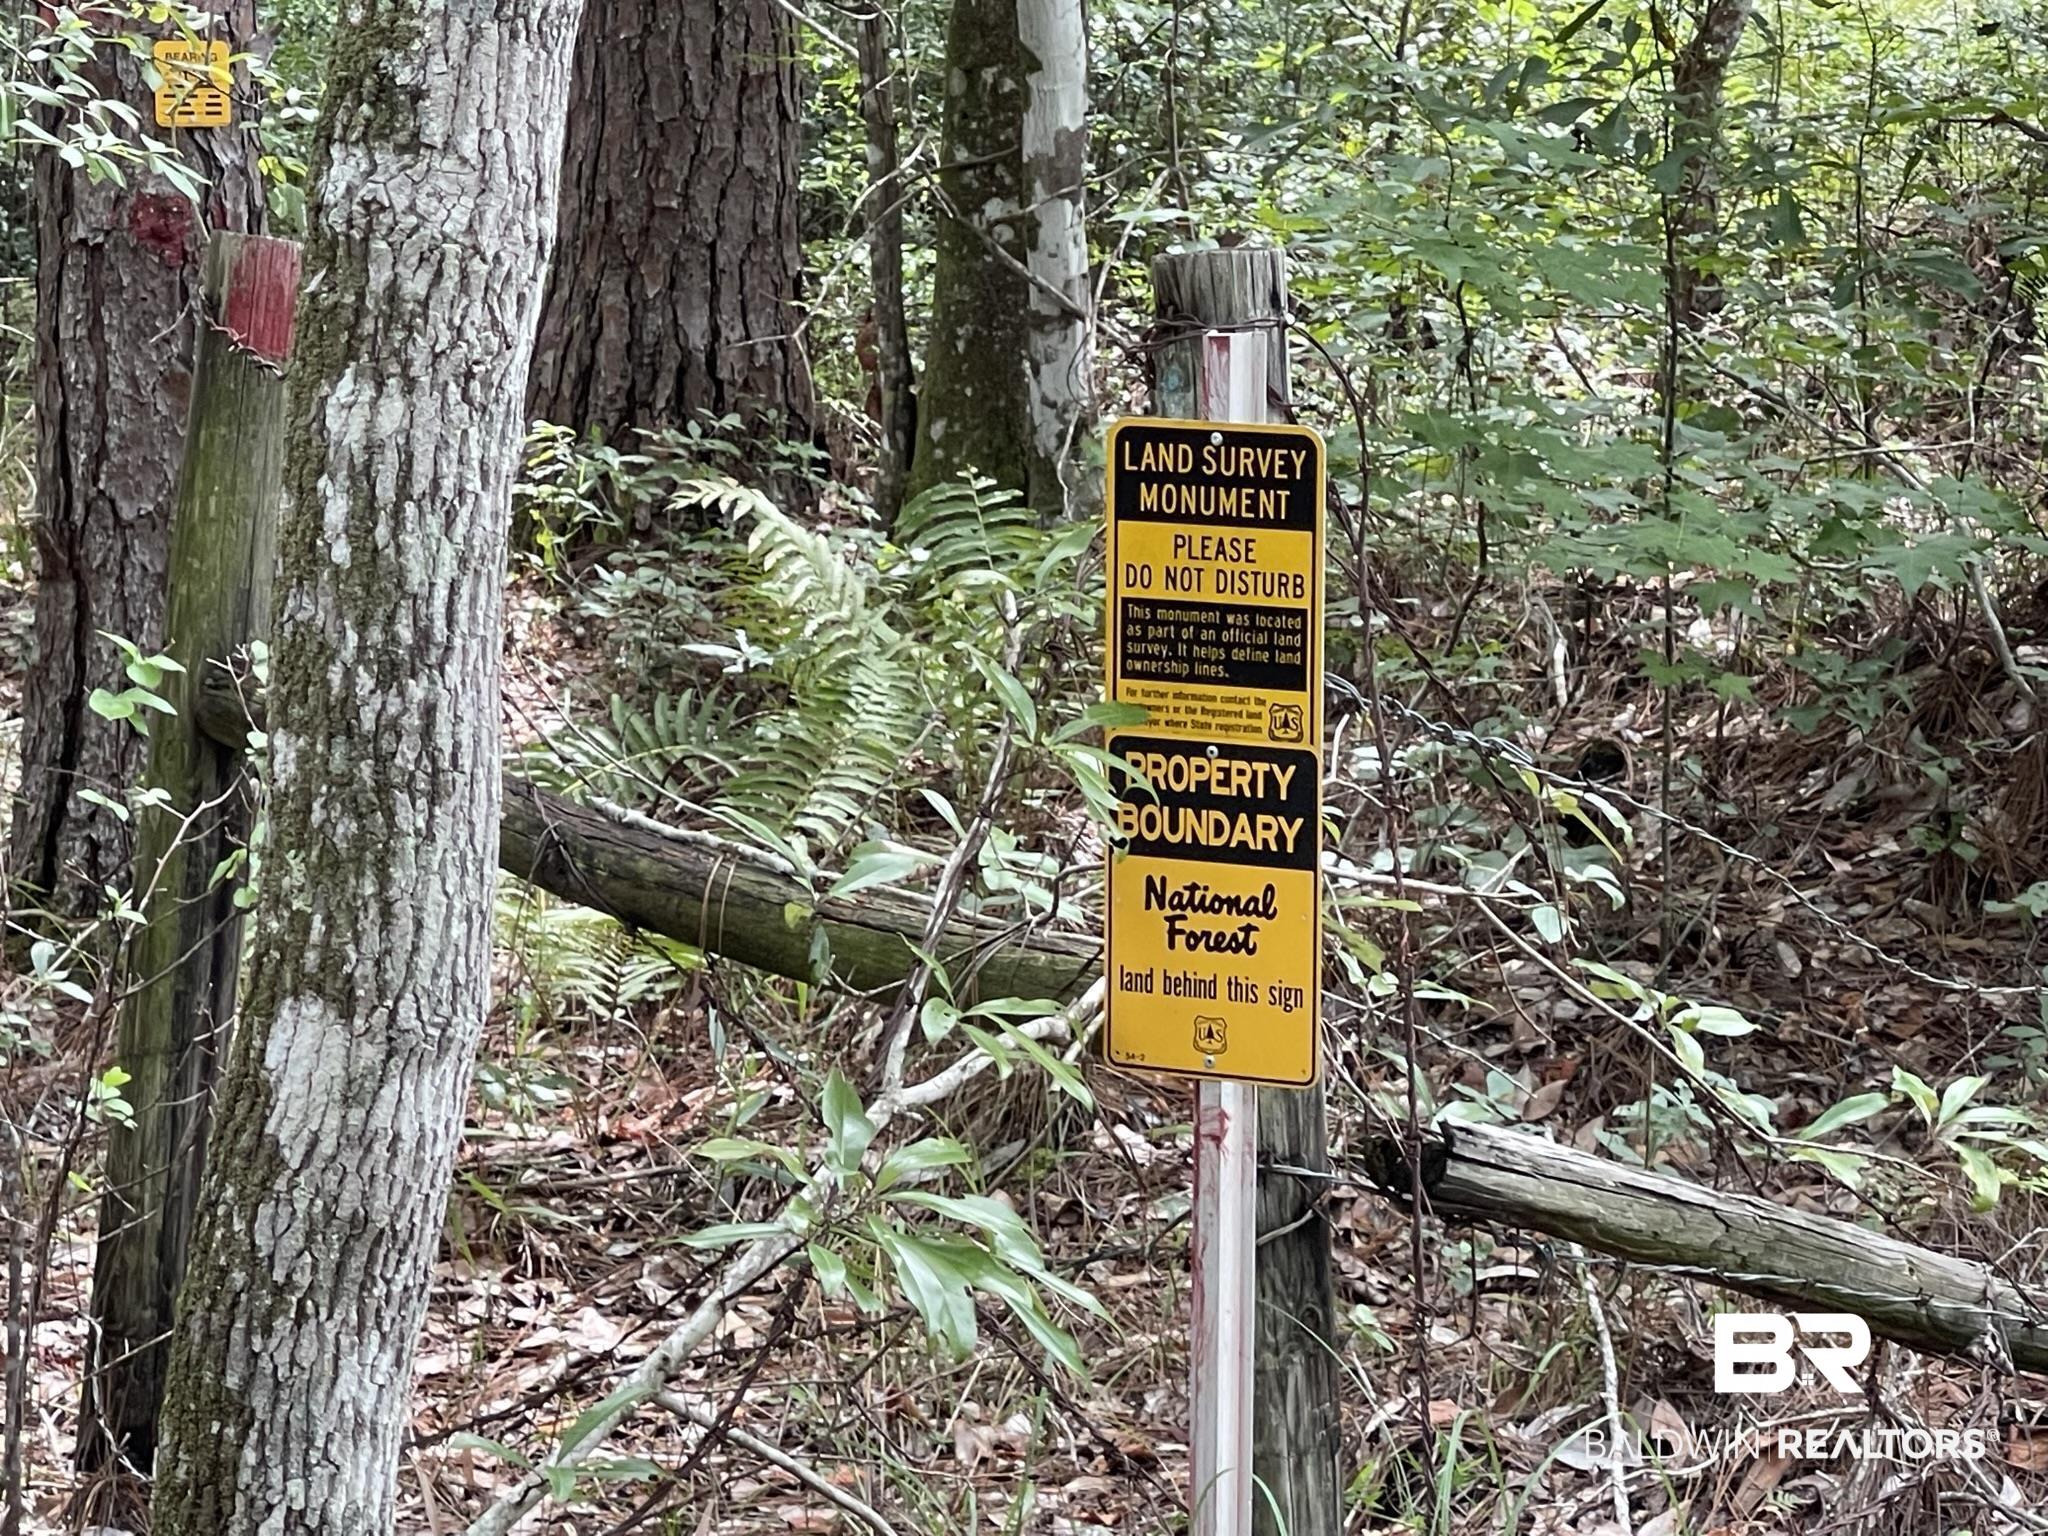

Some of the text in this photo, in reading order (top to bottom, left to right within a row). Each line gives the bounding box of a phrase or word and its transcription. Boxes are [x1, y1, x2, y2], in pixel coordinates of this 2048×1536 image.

[1124, 441, 1306, 480] LAND SURVEY
[1140, 482, 1290, 519] MONUMENT
[1173, 534, 1257, 563] PLEASE
[1125, 563, 1305, 599] DO NOT DISTURB
[1127, 603, 1302, 629] This monument was located
[1126, 624, 1301, 647] as part of an official land
[1126, 641, 1302, 665] survey. It helps define land
[1126, 659, 1230, 678] ownership lines.
[1126, 687, 1267, 707] For further information contact the
[1185, 705, 1197, 715] the
[1201, 706, 1243, 719] Registered
[1164, 719, 1188, 729] where
[1191, 719, 1212, 731] State
[1215, 722, 1262, 734] registration
[1125, 751, 1296, 801] PROPERTY
[1117, 802, 1304, 853] BOUNDARY
[1145, 874, 1278, 920] National
[1163, 914, 1260, 956] Forest
[1119, 964, 1304, 1013] land behind this sign
